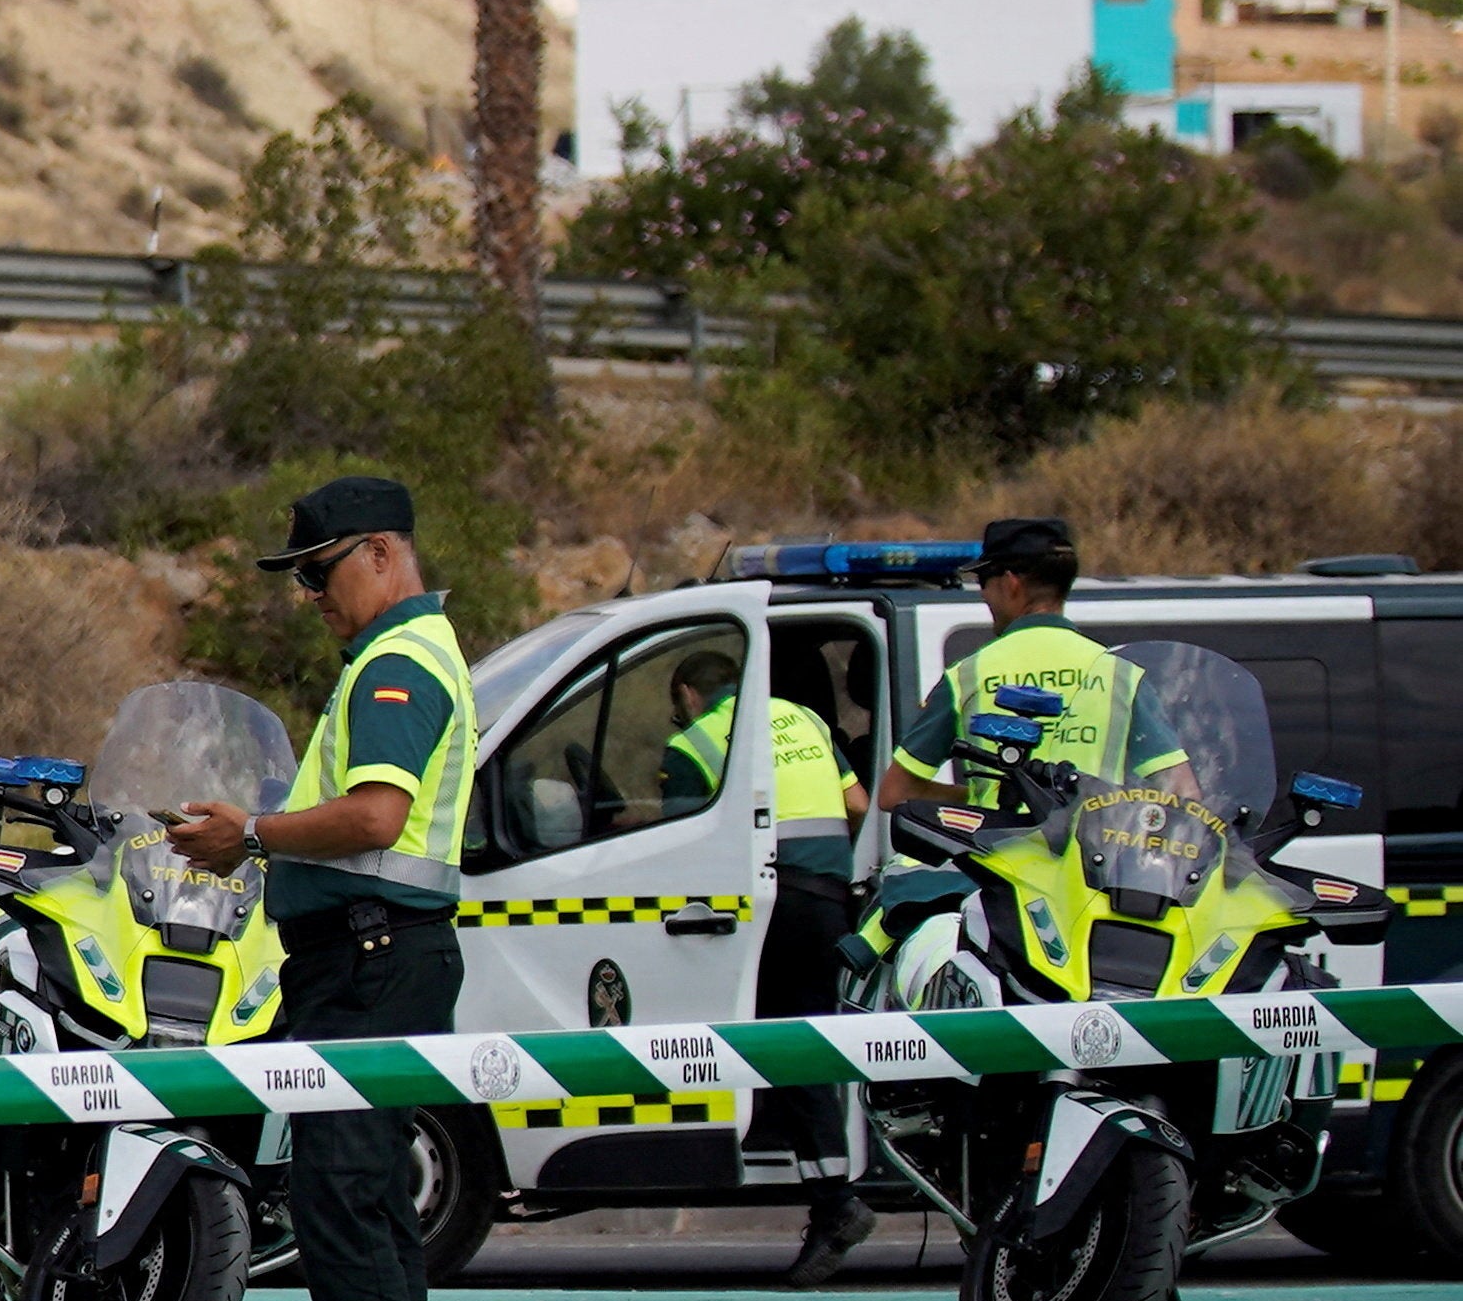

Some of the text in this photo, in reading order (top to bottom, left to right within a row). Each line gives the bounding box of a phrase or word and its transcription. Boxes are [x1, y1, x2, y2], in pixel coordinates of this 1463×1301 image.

[1083, 787, 1229, 838] GUARDIA CIVIL
[1253, 1005, 1318, 1030] GUARDIA
[650, 1037, 715, 1061] GUARDIA
[866, 1039, 927, 1063] TRAFICO
[1283, 1030, 1321, 1049] CIVIL
[51, 1065, 115, 1087] GUARDIA
[265, 1068, 327, 1091] TRAFICO
[683, 1062, 721, 1084] CIVIL
[83, 1089, 122, 1112] CIVIL
[51, 1227, 71, 1256] BMW
